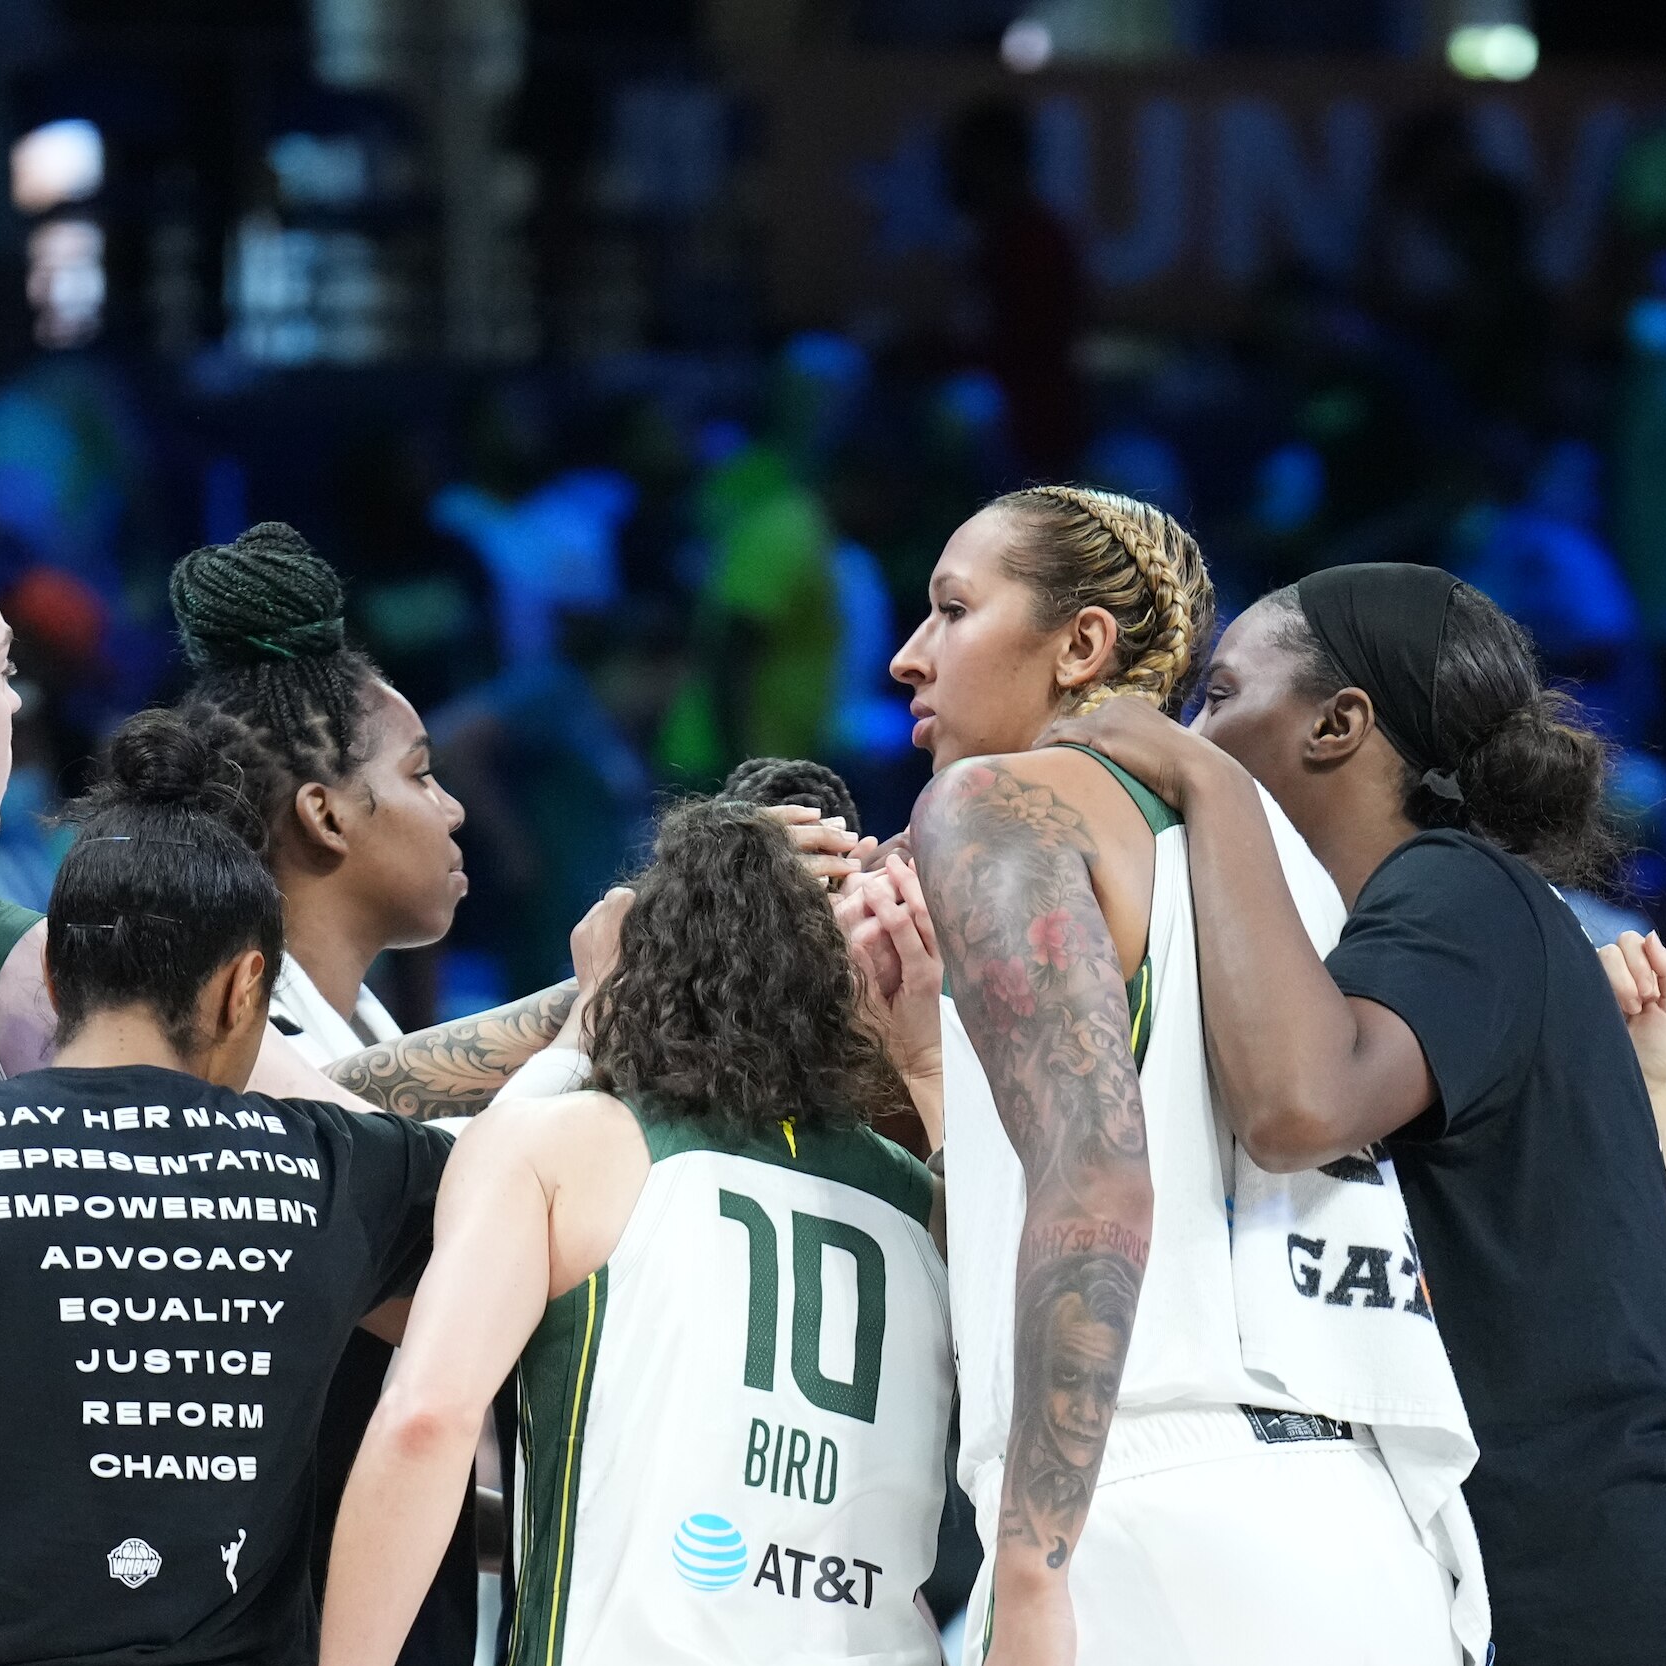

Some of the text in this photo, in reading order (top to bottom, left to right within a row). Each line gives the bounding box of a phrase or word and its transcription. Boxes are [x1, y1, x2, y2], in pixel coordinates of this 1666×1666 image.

[82, 1104, 171, 1130] HER
[183, 1106, 288, 1136] NAME
[40, 1245, 294, 1273] ADVOCACY
[58, 1297, 285, 1327] EQUALITY
[718, 1187, 886, 1425] 10
[75, 1348, 272, 1376] JUSTICE
[82, 1400, 264, 1429] REFORM
[89, 1453, 258, 1482] CHANGE
[744, 1416, 839, 1505] BIRD
[112, 1557, 160, 1576] WNBPA
[752, 1542, 884, 1610] AT&T
